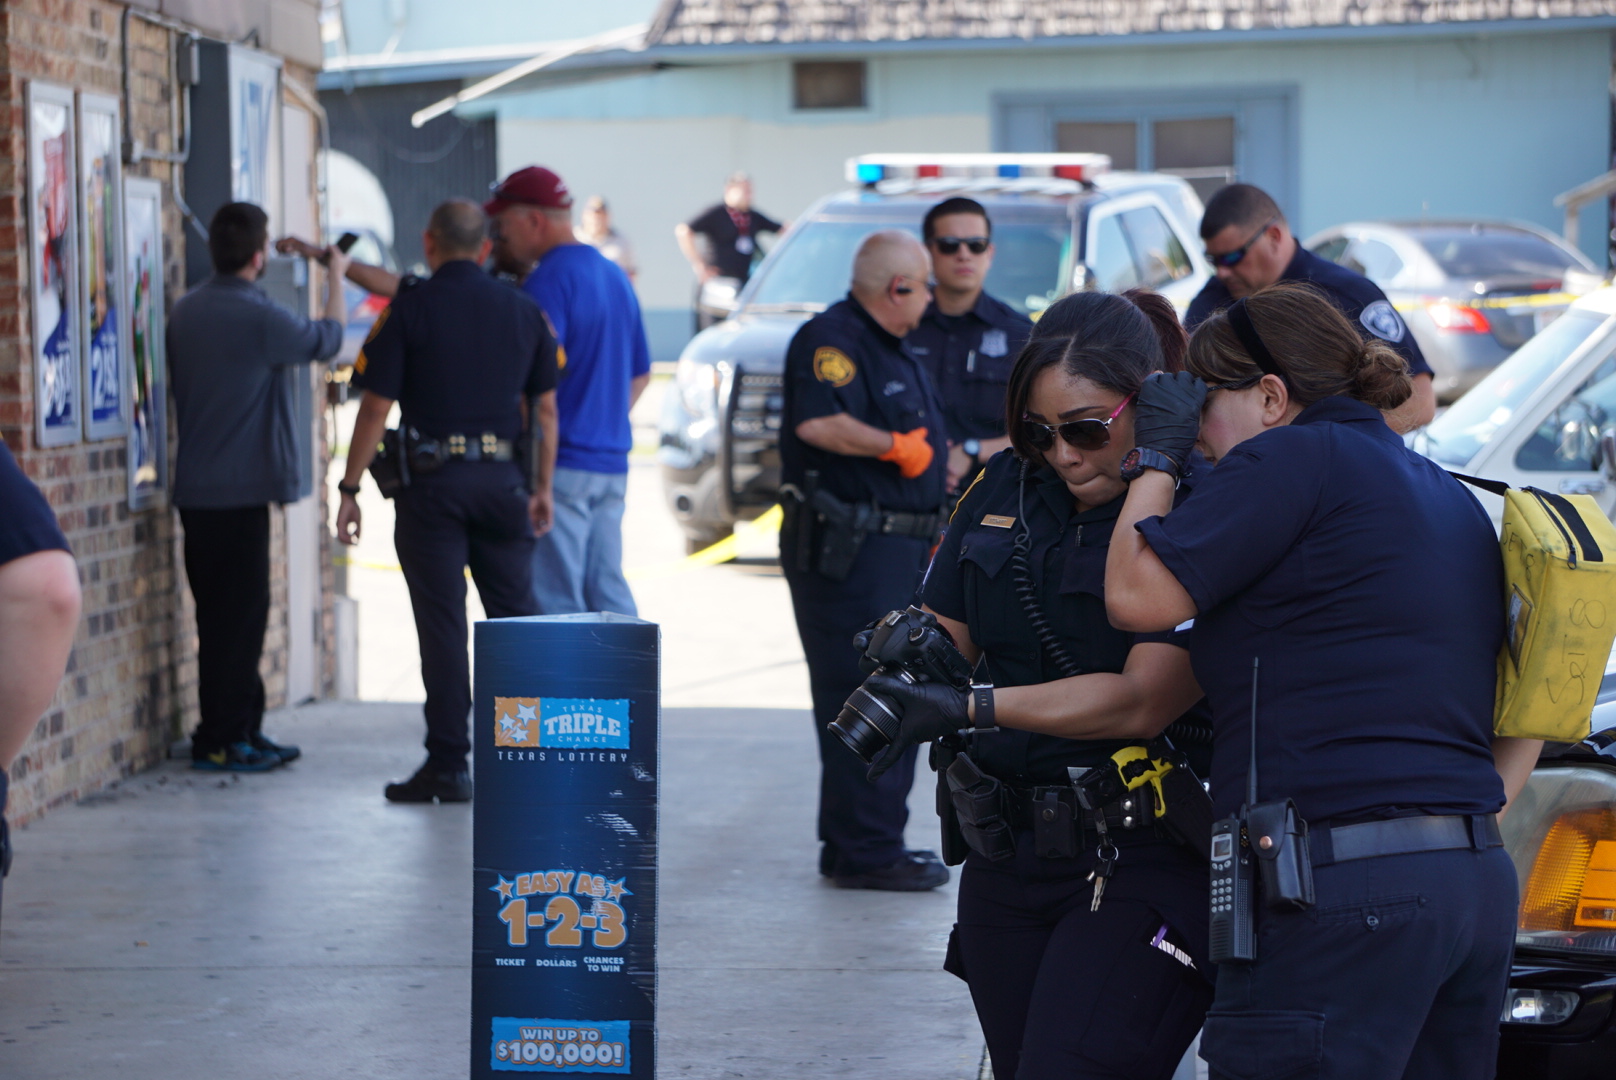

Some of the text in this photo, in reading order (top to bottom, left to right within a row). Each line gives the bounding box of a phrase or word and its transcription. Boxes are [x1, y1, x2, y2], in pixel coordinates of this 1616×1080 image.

[562, 704, 603, 713] TEXAS
[543, 712, 621, 737] TRIPLE
[557, 735, 607, 743] CHANCE
[497, 750, 628, 763] TEXAS LOTTERY
[515, 871, 607, 898] EASY AS
[498, 895, 627, 948] 1-2-3
[495, 956, 625, 968] TICKET DOLLARS CHANCES
[587, 964, 621, 973] TO WIN
[521, 1028, 600, 1042] WIN UP TO
[498, 1041, 623, 1066] $100,000!
